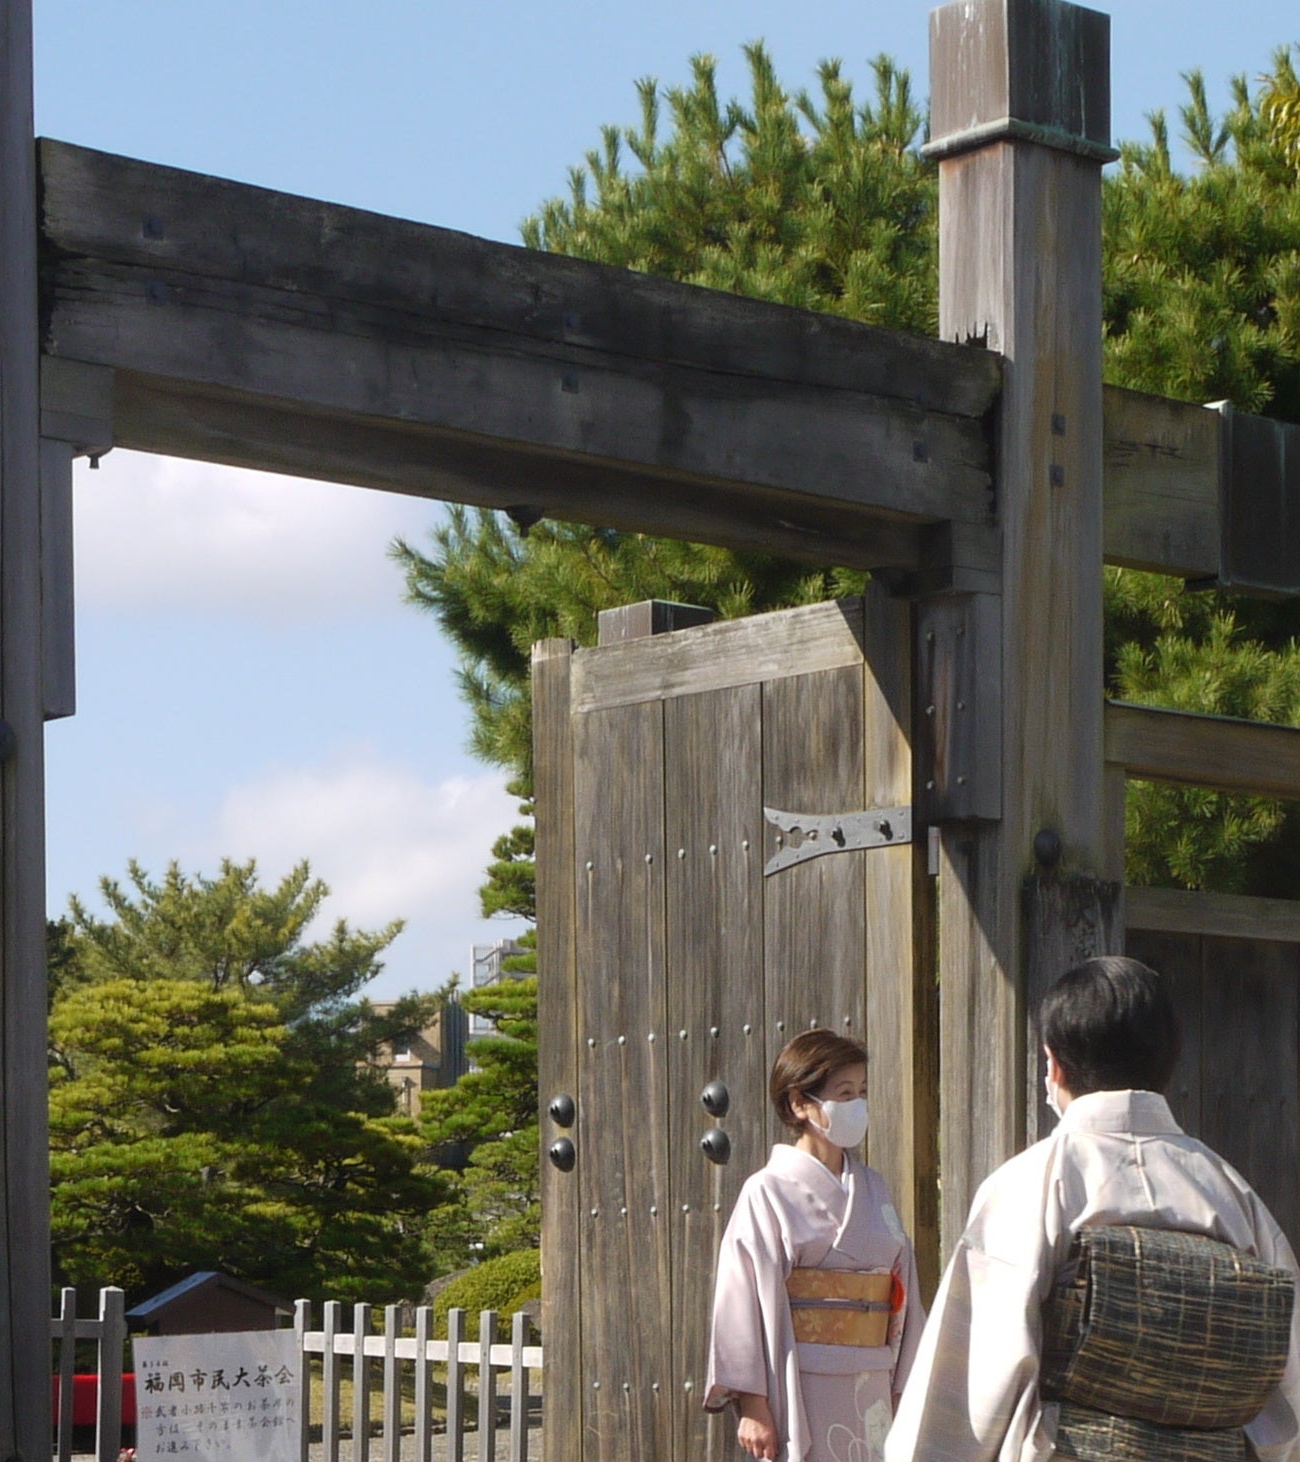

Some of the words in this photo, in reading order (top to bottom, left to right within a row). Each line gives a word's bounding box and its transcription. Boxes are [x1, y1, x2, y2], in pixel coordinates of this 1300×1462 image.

[144, 1364, 294, 1394] 福岡市民大茶会
